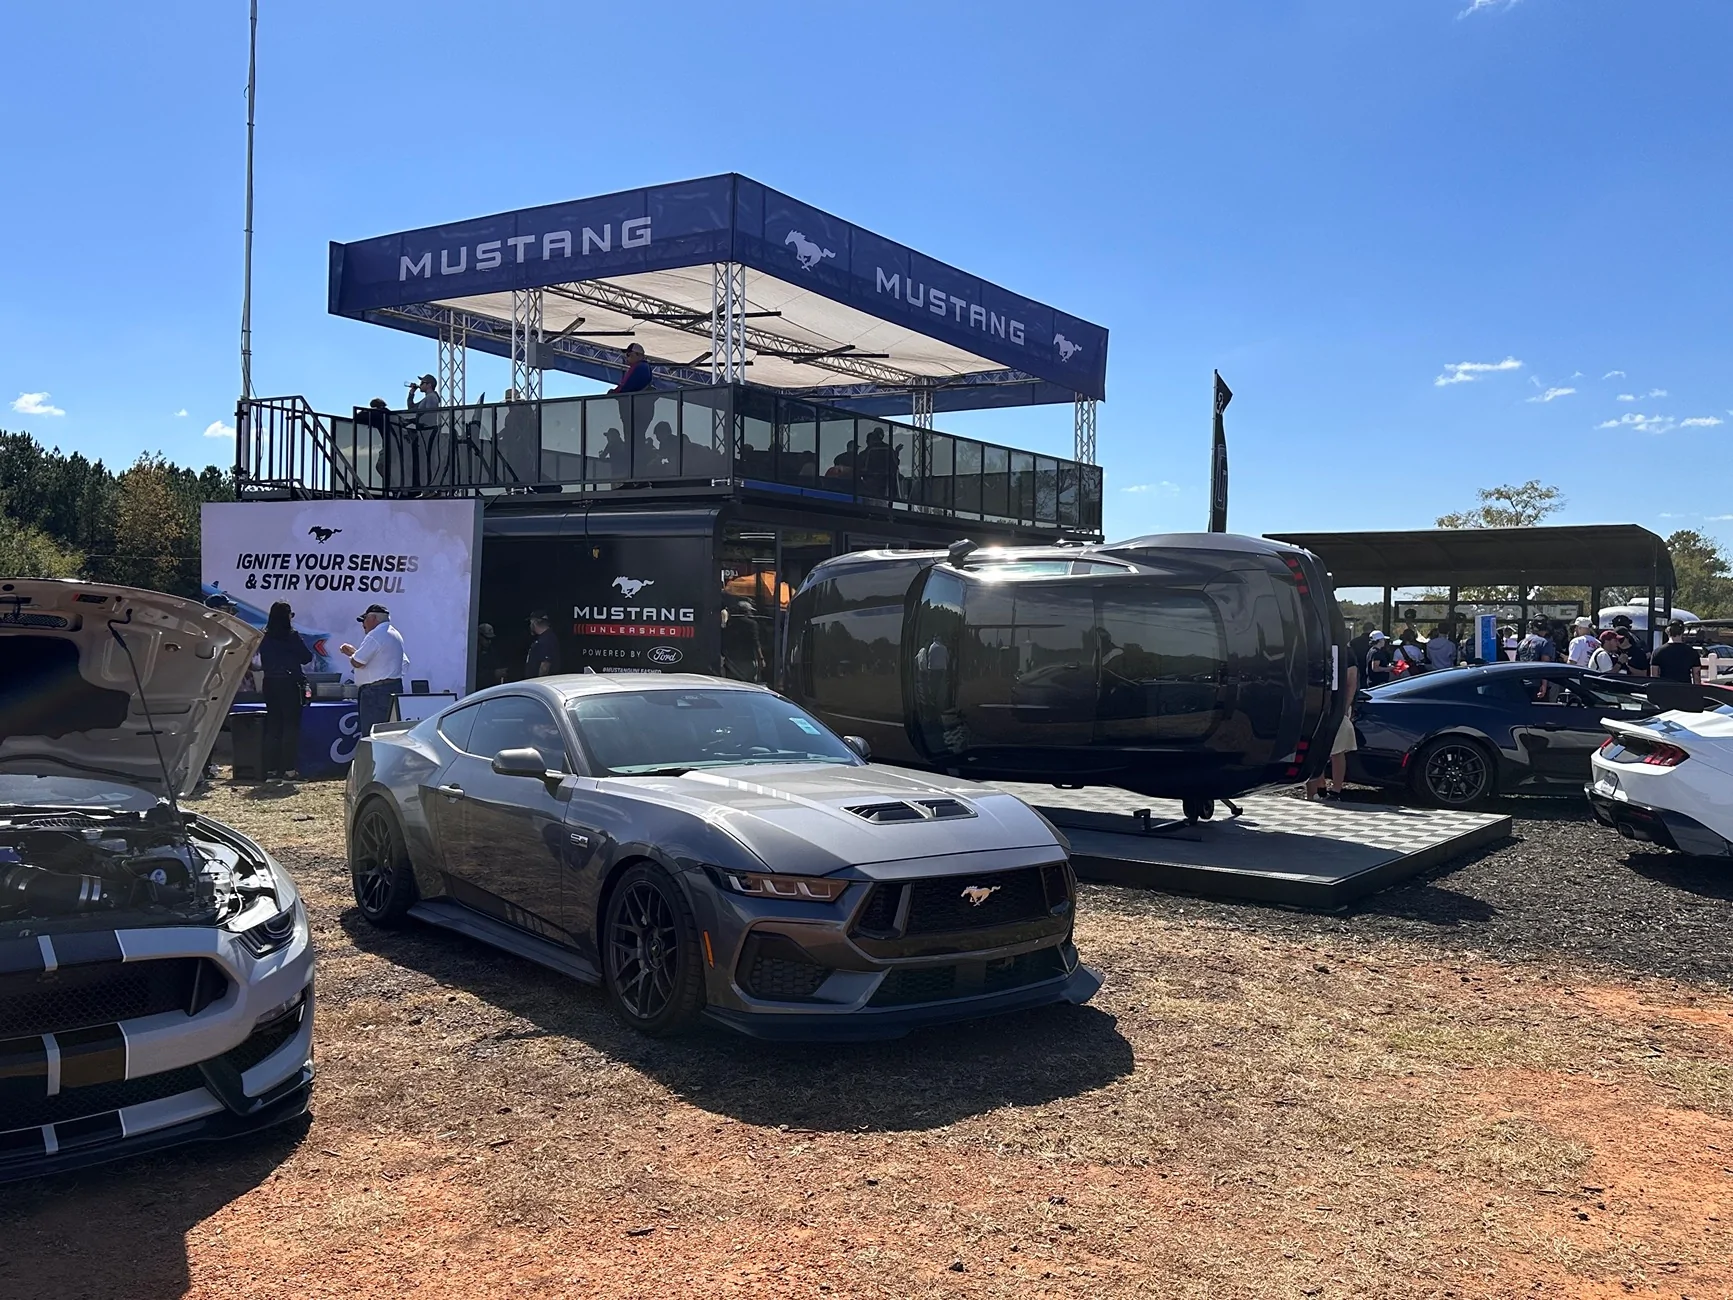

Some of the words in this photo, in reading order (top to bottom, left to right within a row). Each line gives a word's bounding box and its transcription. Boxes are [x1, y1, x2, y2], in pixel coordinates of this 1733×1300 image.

[399, 216, 652, 282] MUSTANG
[876, 266, 1025, 346] MUSTANG
[236, 553, 292, 570] IGNITE
[295, 553, 345, 571] YOUR
[347, 554, 419, 573] SENSES
[245, 573, 257, 590] &
[260, 574, 300, 591] STIR
[304, 574, 356, 592] YOUR
[357, 575, 406, 594] SOUL
[573, 606, 695, 621] MUSTANG
[590, 626, 676, 635] UNLEASHED
[582, 648, 626, 658] POWERED
[630, 650, 642, 658] BY
[651, 648, 678, 662] Ford
